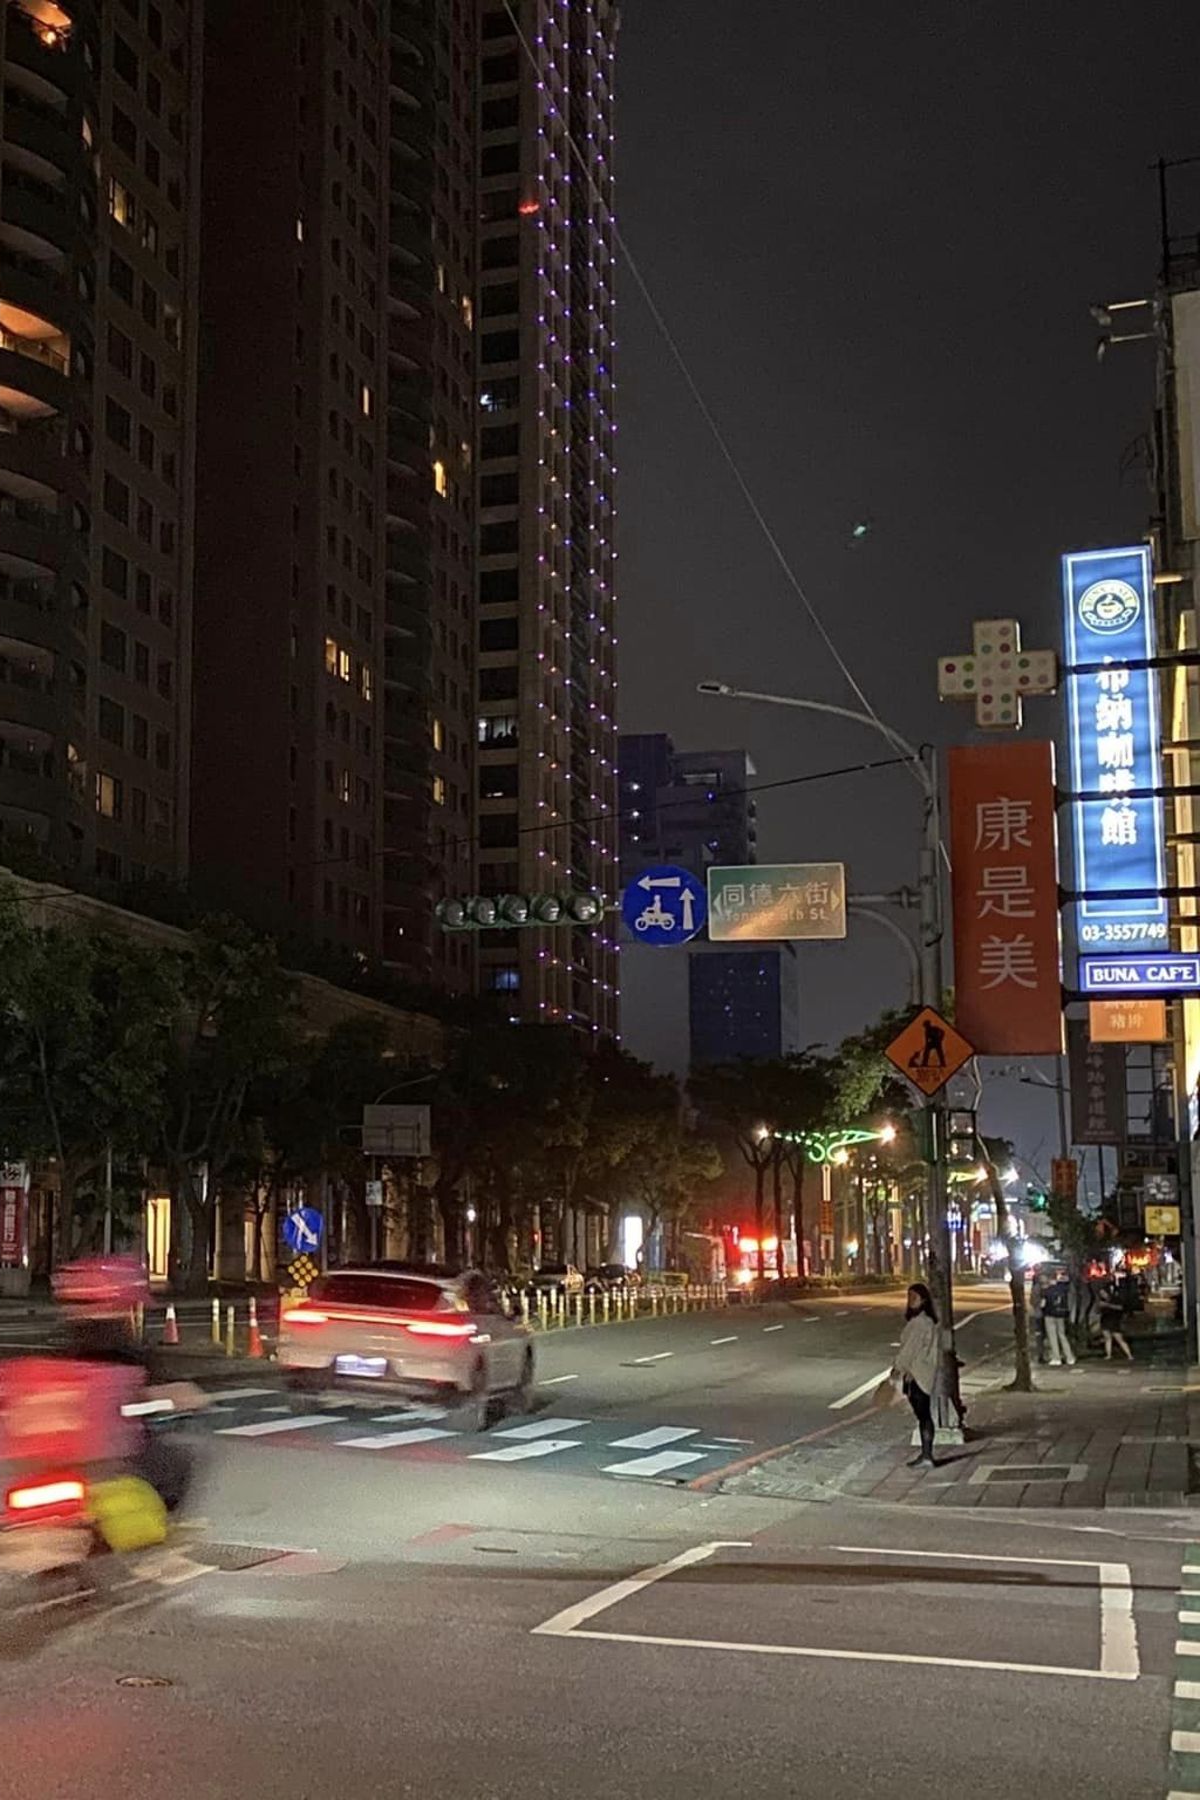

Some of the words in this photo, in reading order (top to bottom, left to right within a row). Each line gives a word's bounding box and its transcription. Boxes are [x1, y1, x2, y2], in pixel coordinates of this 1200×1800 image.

[723, 881, 829, 906] 同德六街
[975, 797, 1037, 989] 康是美
[1082, 923, 1166, 941] 03-3557749
[1092, 967, 1140, 982] BUNA
